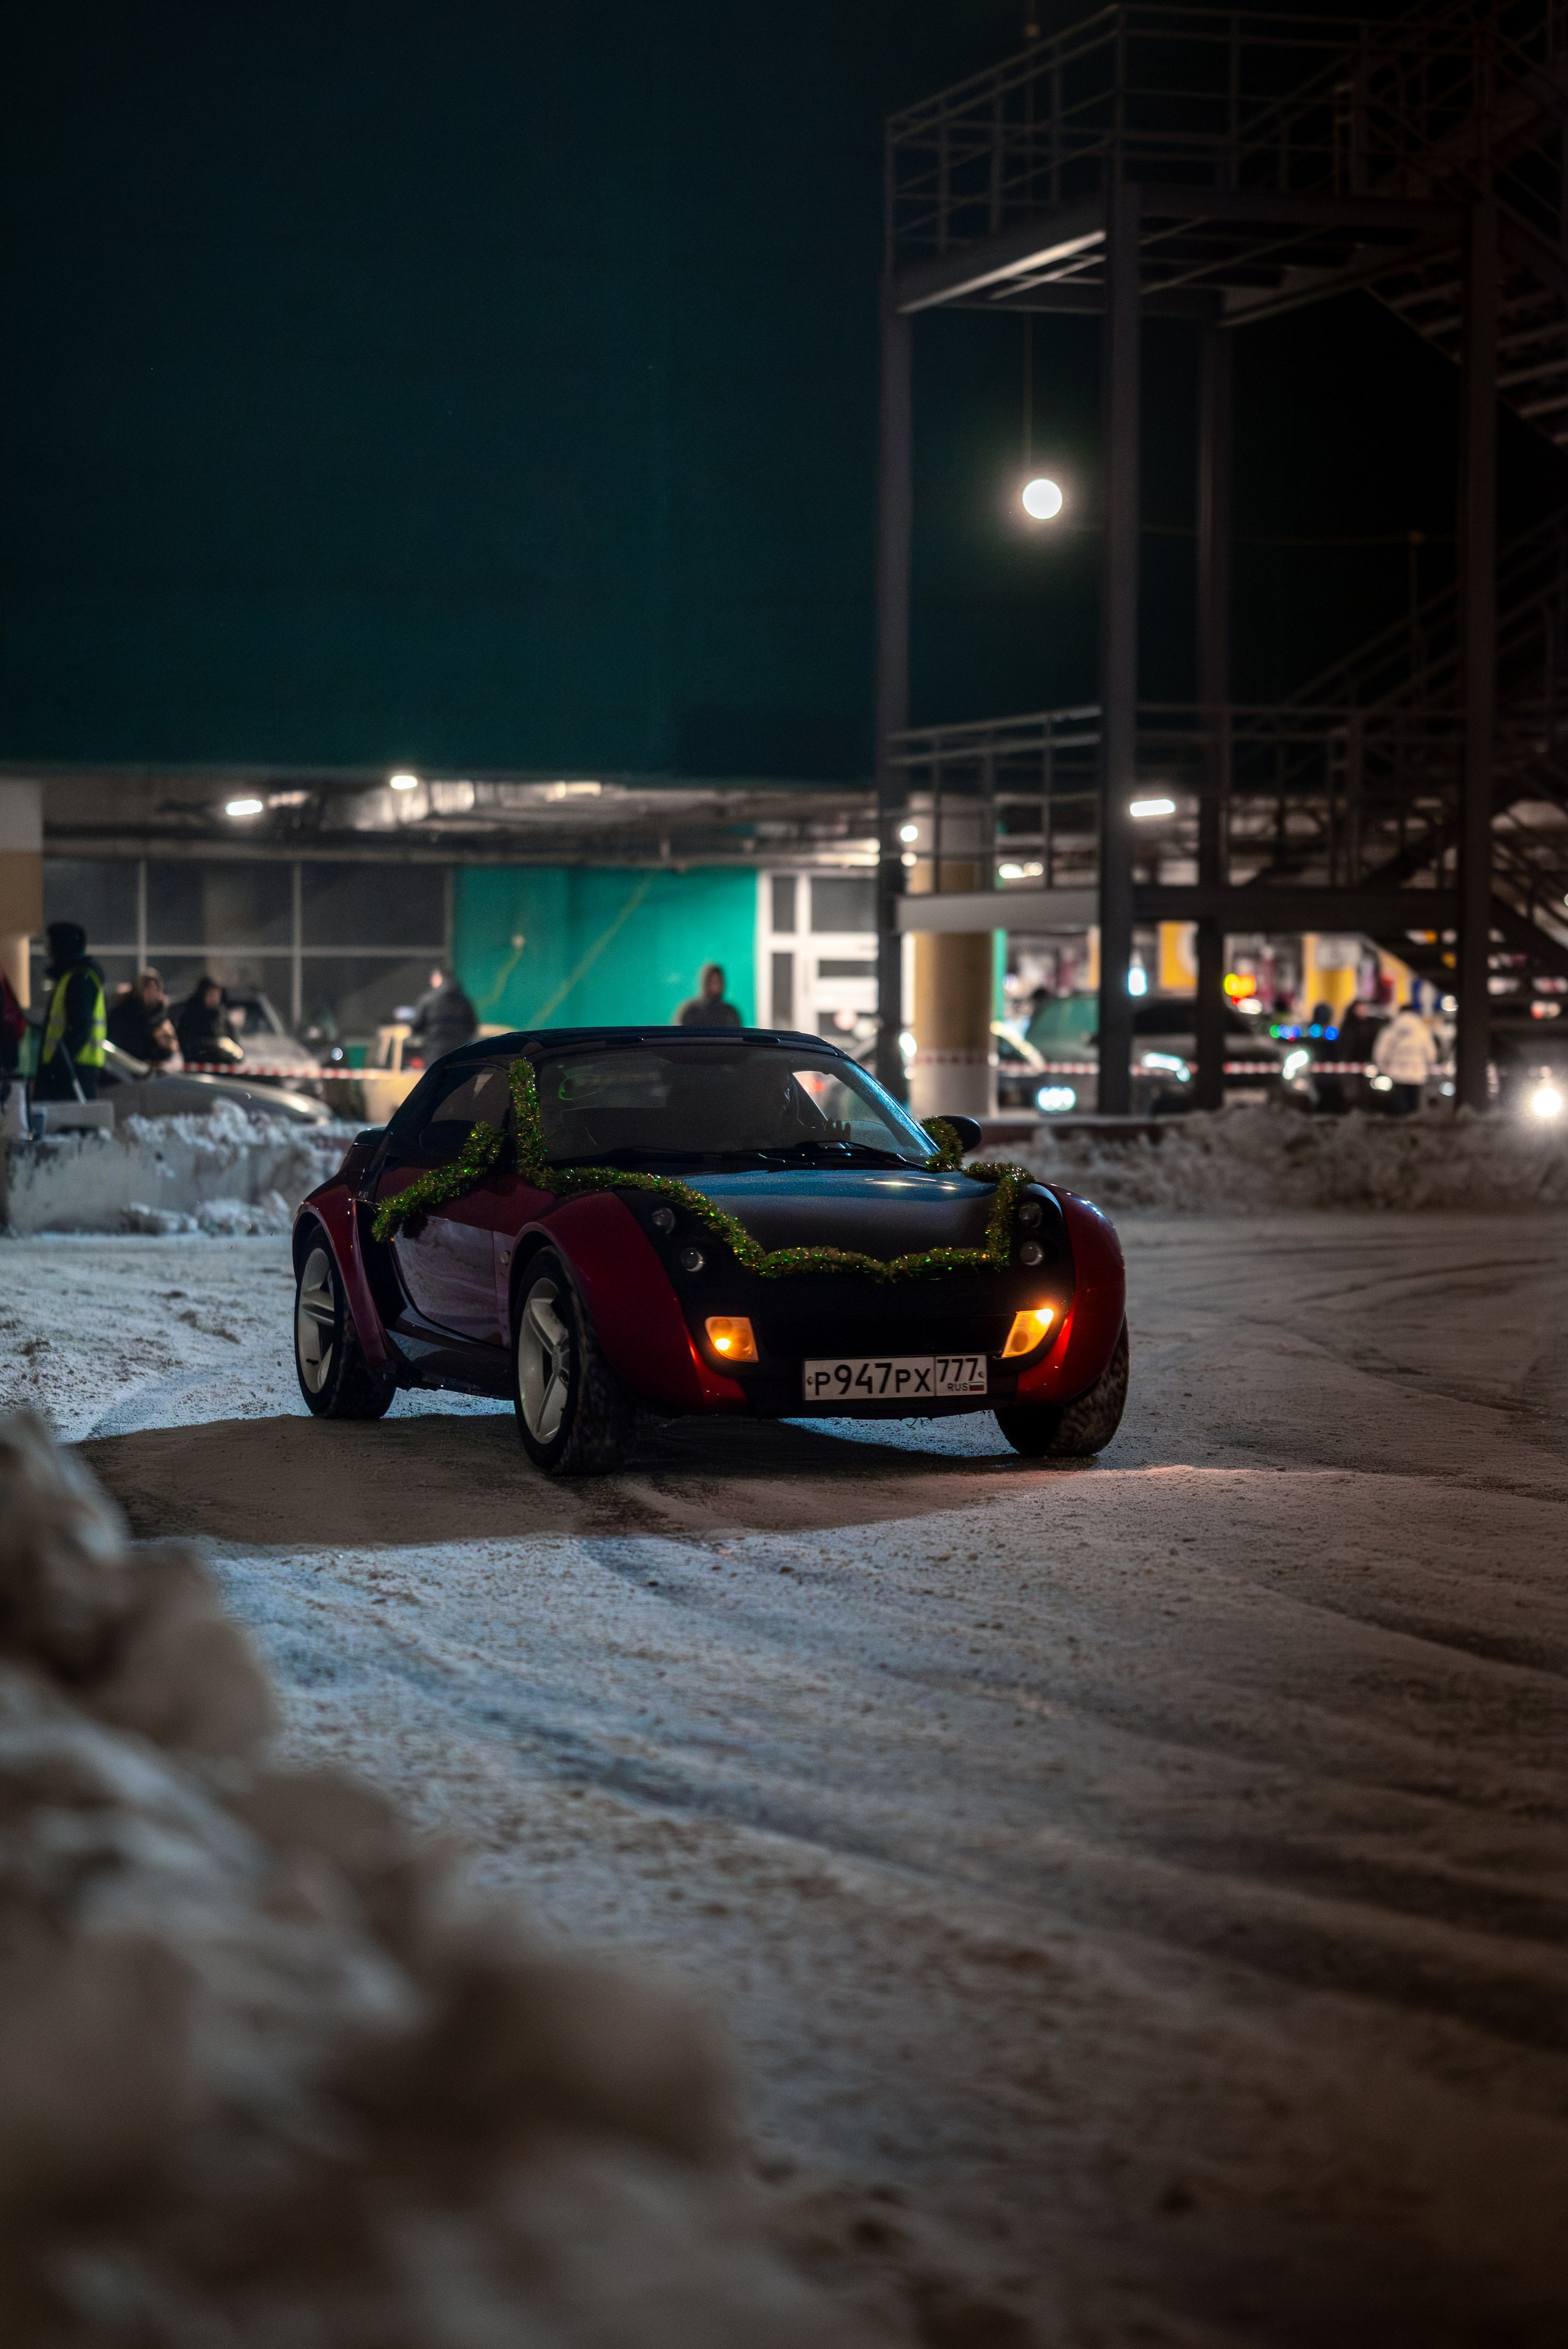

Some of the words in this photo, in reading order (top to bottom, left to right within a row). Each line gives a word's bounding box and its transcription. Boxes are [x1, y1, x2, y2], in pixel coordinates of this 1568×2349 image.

[815, 1362, 931, 1396] P947PX
[937, 1357, 979, 1382] 777
[947, 1382, 968, 1392] RUS
